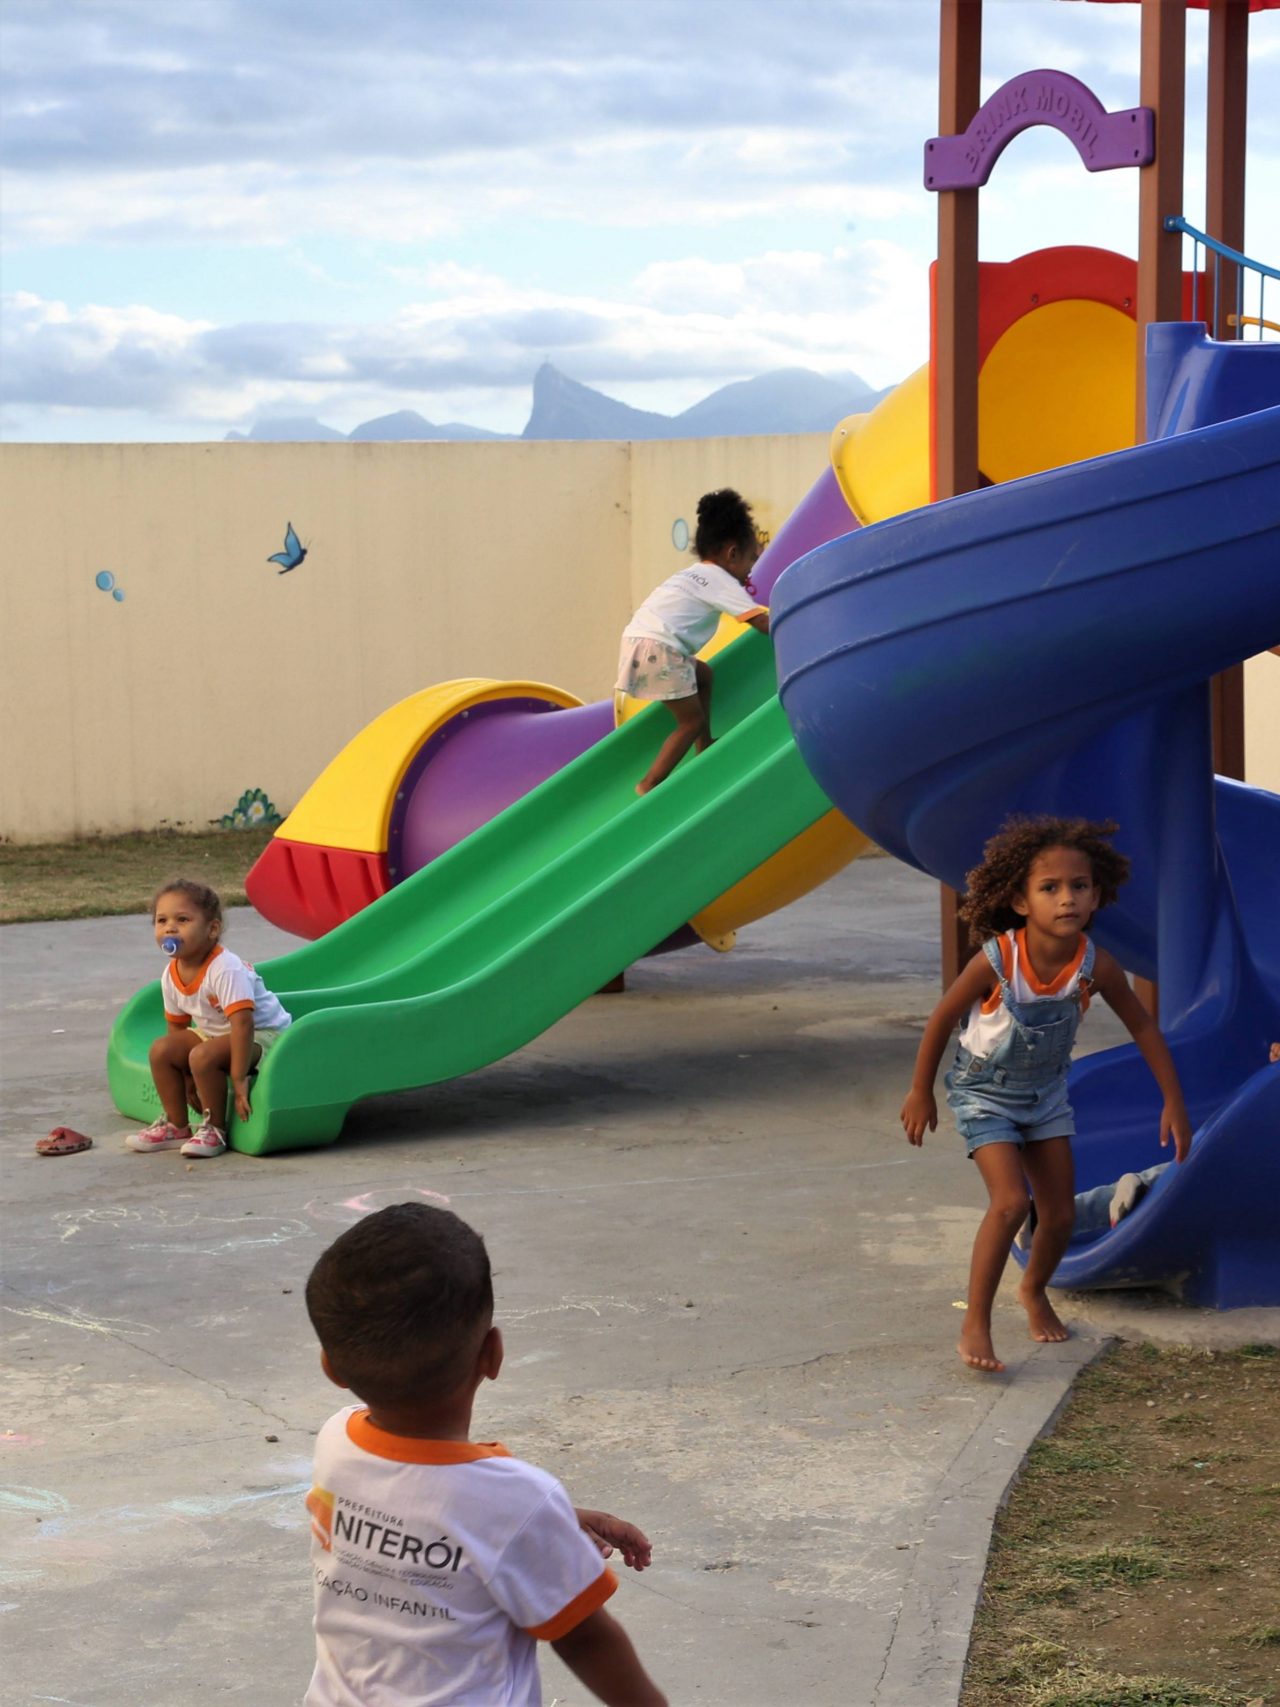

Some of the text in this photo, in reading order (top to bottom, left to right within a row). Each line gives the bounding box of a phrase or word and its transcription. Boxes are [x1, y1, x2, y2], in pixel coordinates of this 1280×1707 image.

[964, 85, 1102, 174] BRINK MOBIL
[334, 1510, 464, 1573] NITERÓI
[337, 1497, 405, 1528] PREFEITURA
[315, 1567, 369, 1602] CAÇÃO
[373, 1593, 458, 1622] INFANTIL
